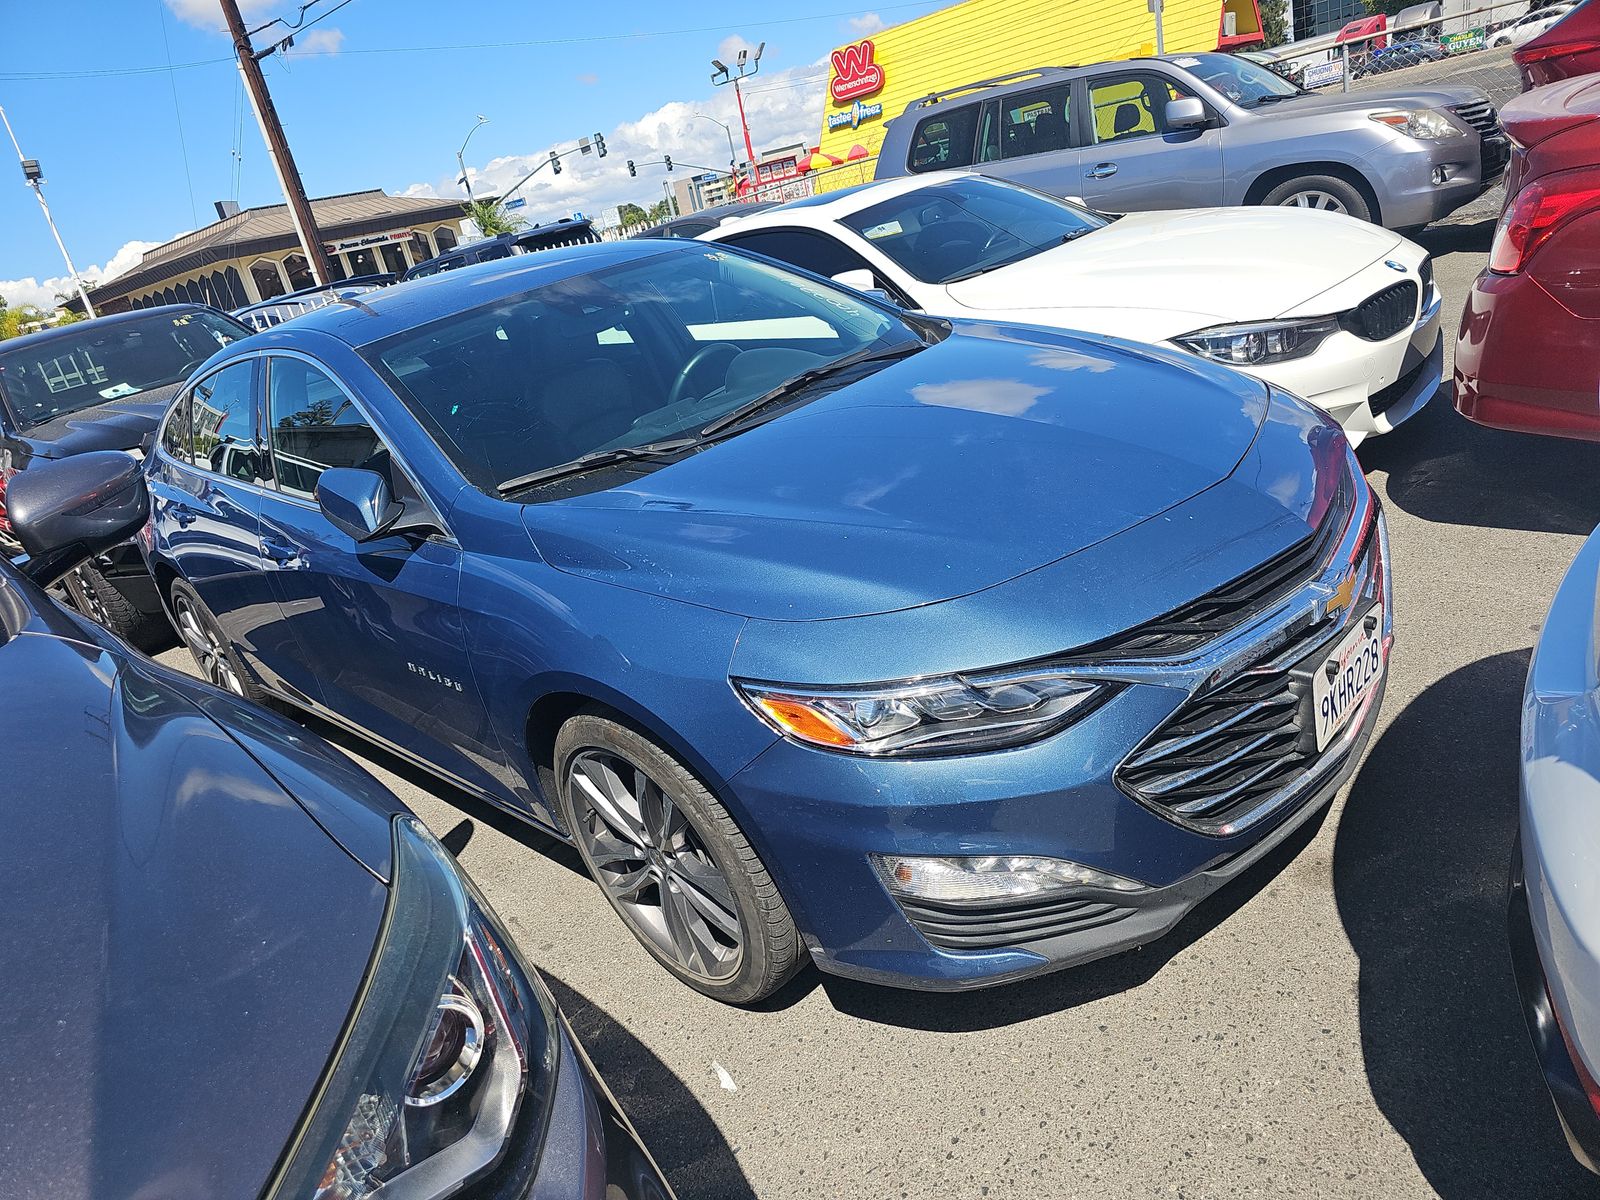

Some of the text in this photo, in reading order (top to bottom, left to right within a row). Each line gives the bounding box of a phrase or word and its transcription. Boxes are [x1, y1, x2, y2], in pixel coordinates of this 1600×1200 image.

[1449, 36, 1484, 50] GUYEN
[832, 42, 871, 80] W
[834, 73, 878, 93] Wienerschnitzel
[829, 104, 881, 128] tastee freez
[407, 662, 463, 692] MALIBU
[1321, 638, 1379, 736] 9KHR228
